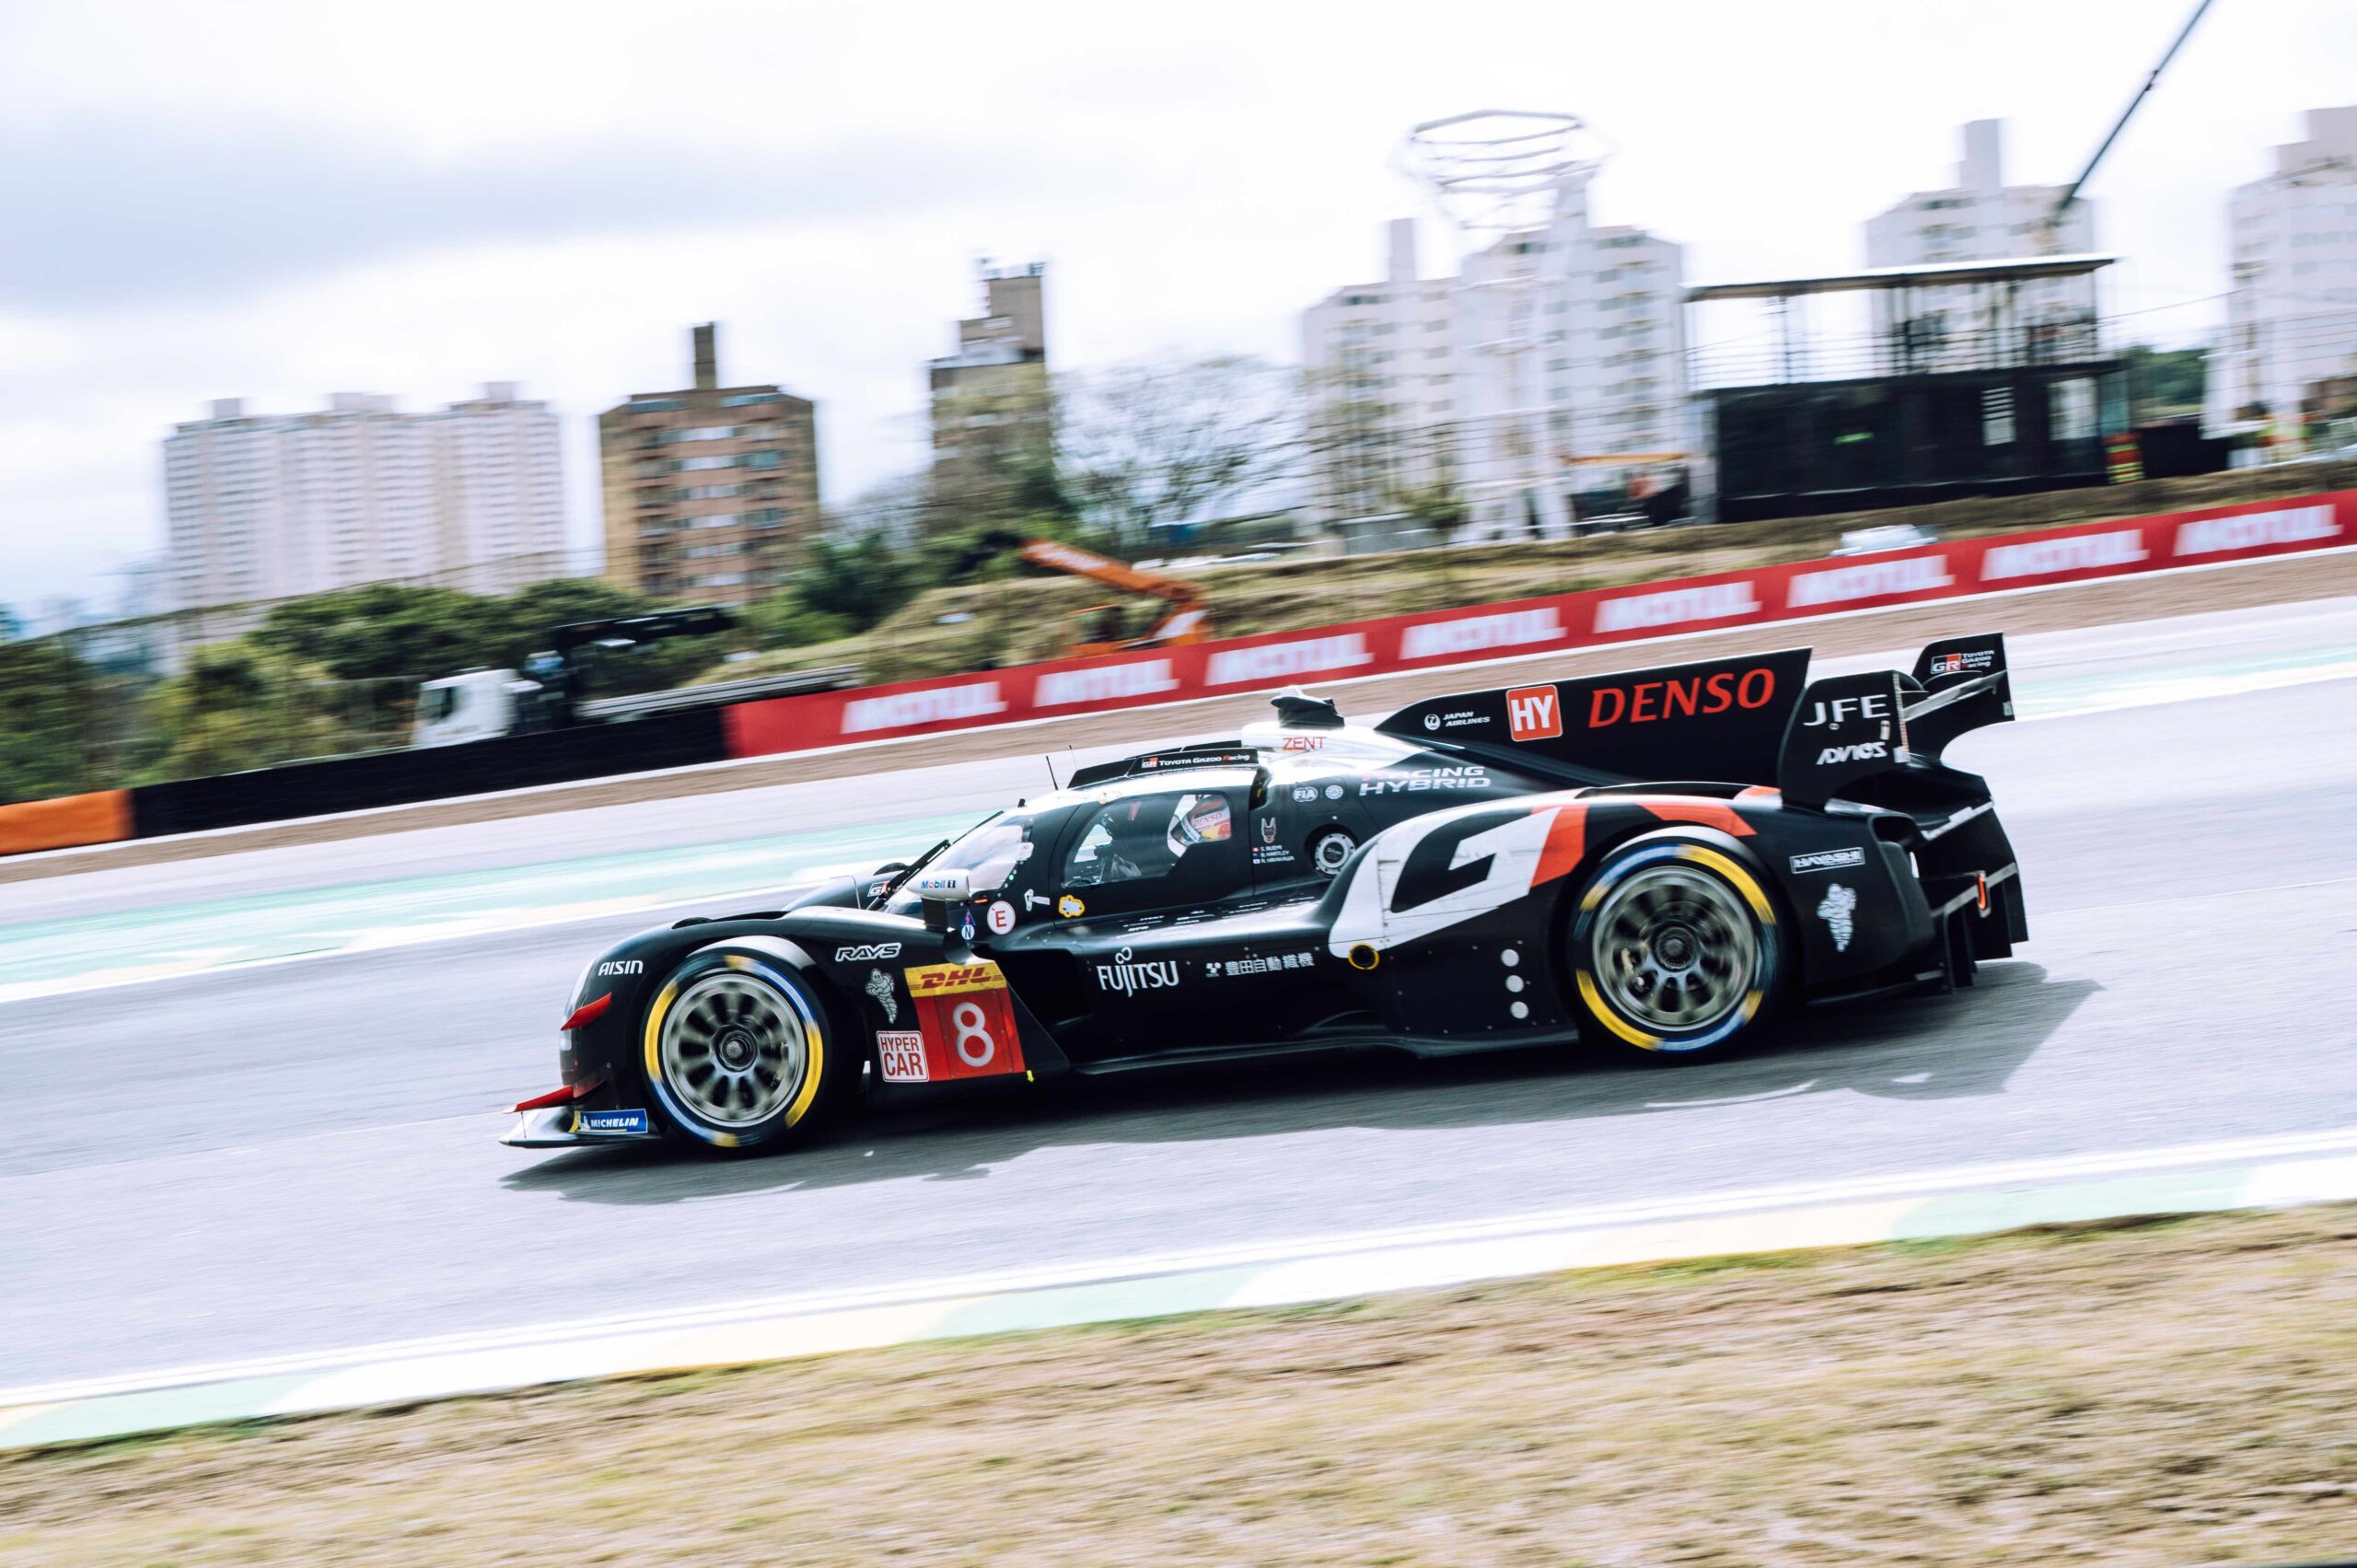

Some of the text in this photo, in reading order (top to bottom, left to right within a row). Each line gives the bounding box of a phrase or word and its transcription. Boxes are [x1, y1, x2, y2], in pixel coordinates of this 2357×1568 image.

[1933, 660, 1960, 672] GR
[1588, 668, 1775, 728] DENSO
[1443, 711, 1474, 720] JAPAN
[1510, 694, 1554, 733] HY
[1803, 694, 1890, 726] JFE
[1446, 716, 1491, 726] AIRLINES
[1282, 737, 1328, 750] ZENT
[1159, 759, 1191, 767] TOYOTA
[1359, 778, 1492, 796] HYBRID
[921, 880, 946, 889] Mobil
[995, 911, 1007, 928] E
[835, 943, 901, 961] RAYS
[598, 960, 644, 976] AISIN
[921, 967, 992, 989] DHL
[1097, 961, 1179, 997] FUJITSU
[953, 1002, 994, 1067] 8
[881, 1036, 919, 1052] HYPER
[884, 1052, 923, 1076] CAR
[590, 1117, 639, 1128] MICHELIN
